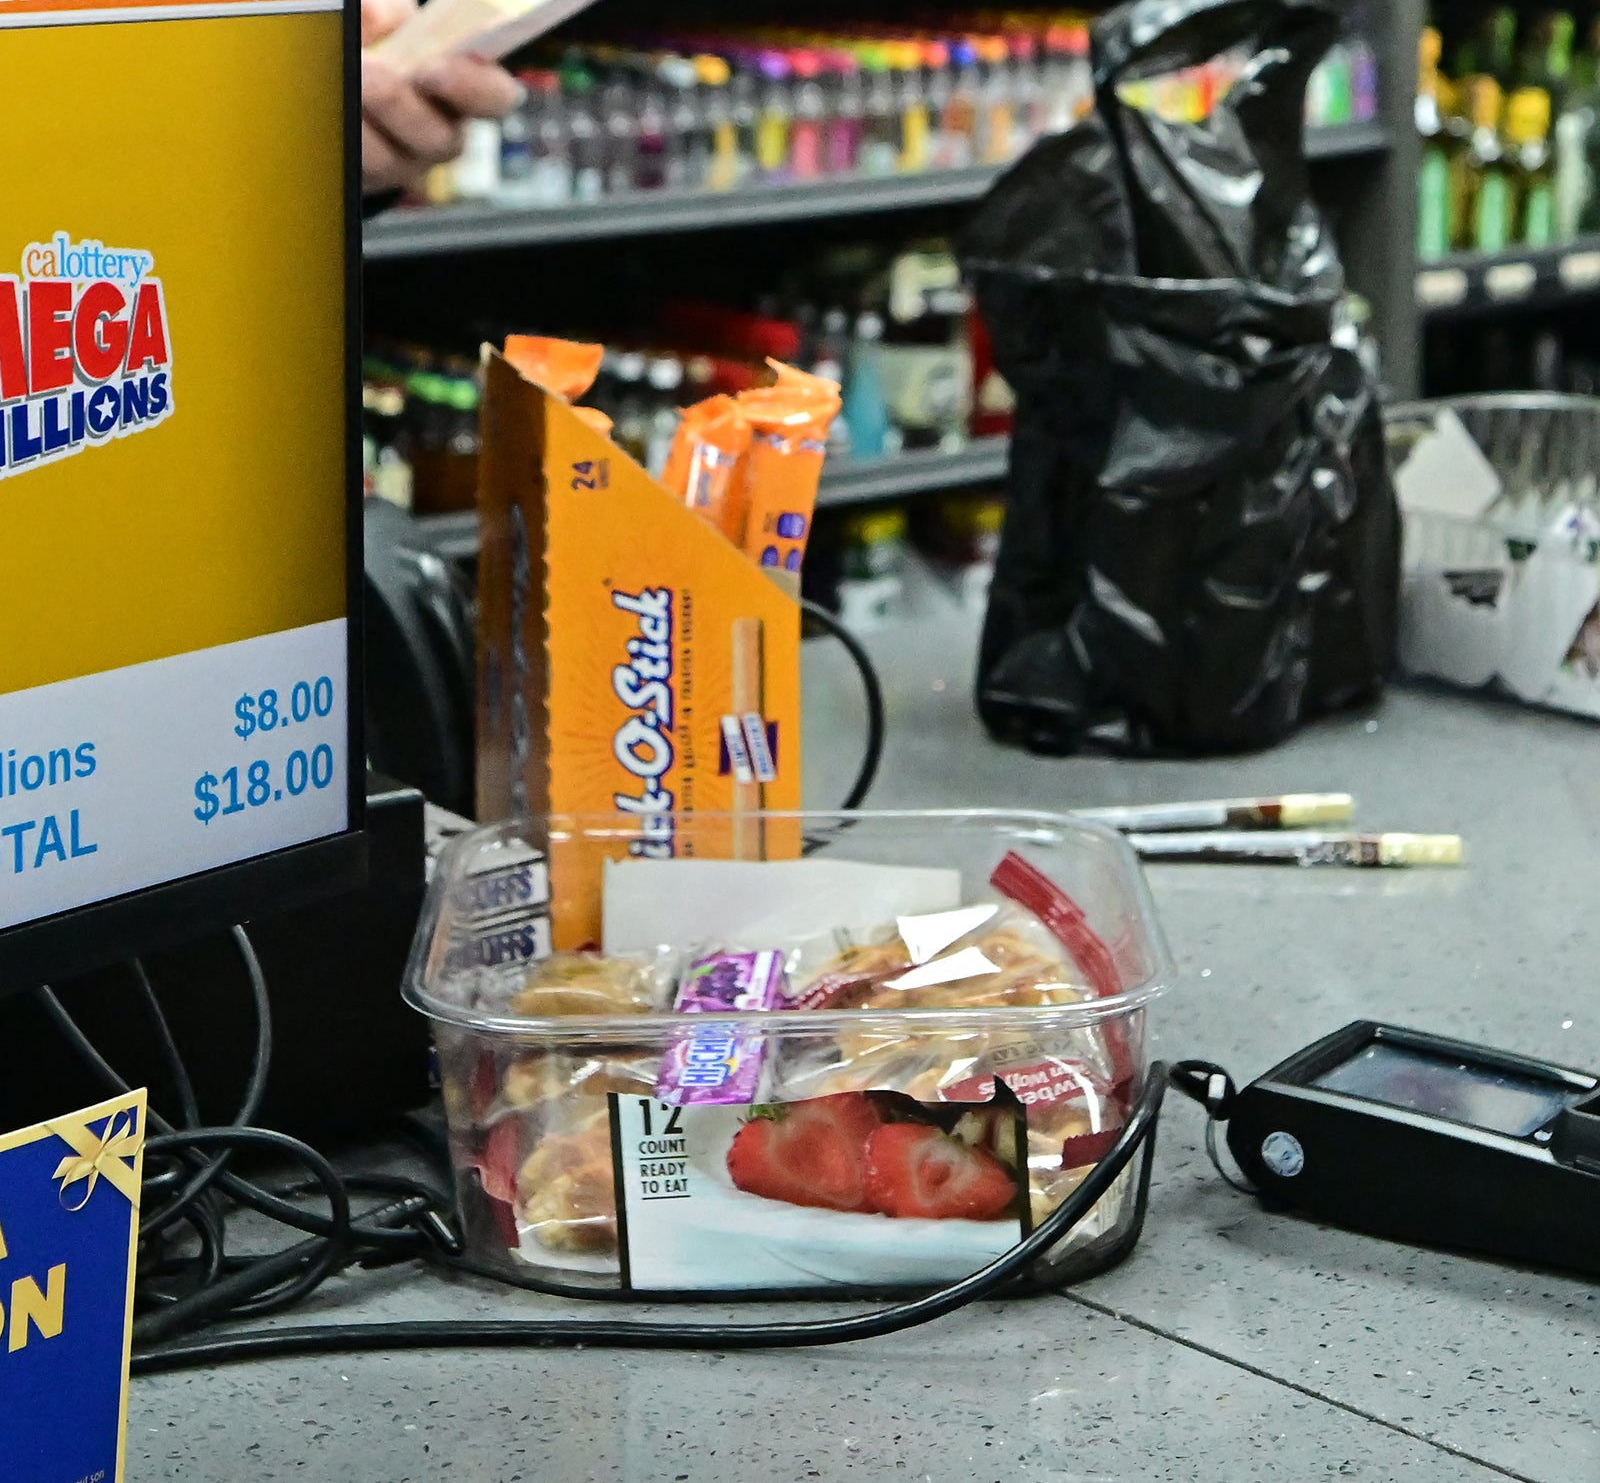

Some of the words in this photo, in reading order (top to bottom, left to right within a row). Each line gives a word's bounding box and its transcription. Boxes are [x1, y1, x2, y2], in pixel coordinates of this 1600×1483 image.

[26, 238, 149, 286] calottery
[571, 461, 595, 490] 24
[234, 677, 333, 739] $8.00
[612, 587, 674, 859] ick-O-Stick
[193, 744, 333, 824] $18.00
[639, 1099, 684, 1135] 12
[639, 1138, 686, 1154] COUNT
[640, 1162, 686, 1177] READY
[642, 1180, 659, 1193] TO
[665, 1178, 687, 1192] EAT
